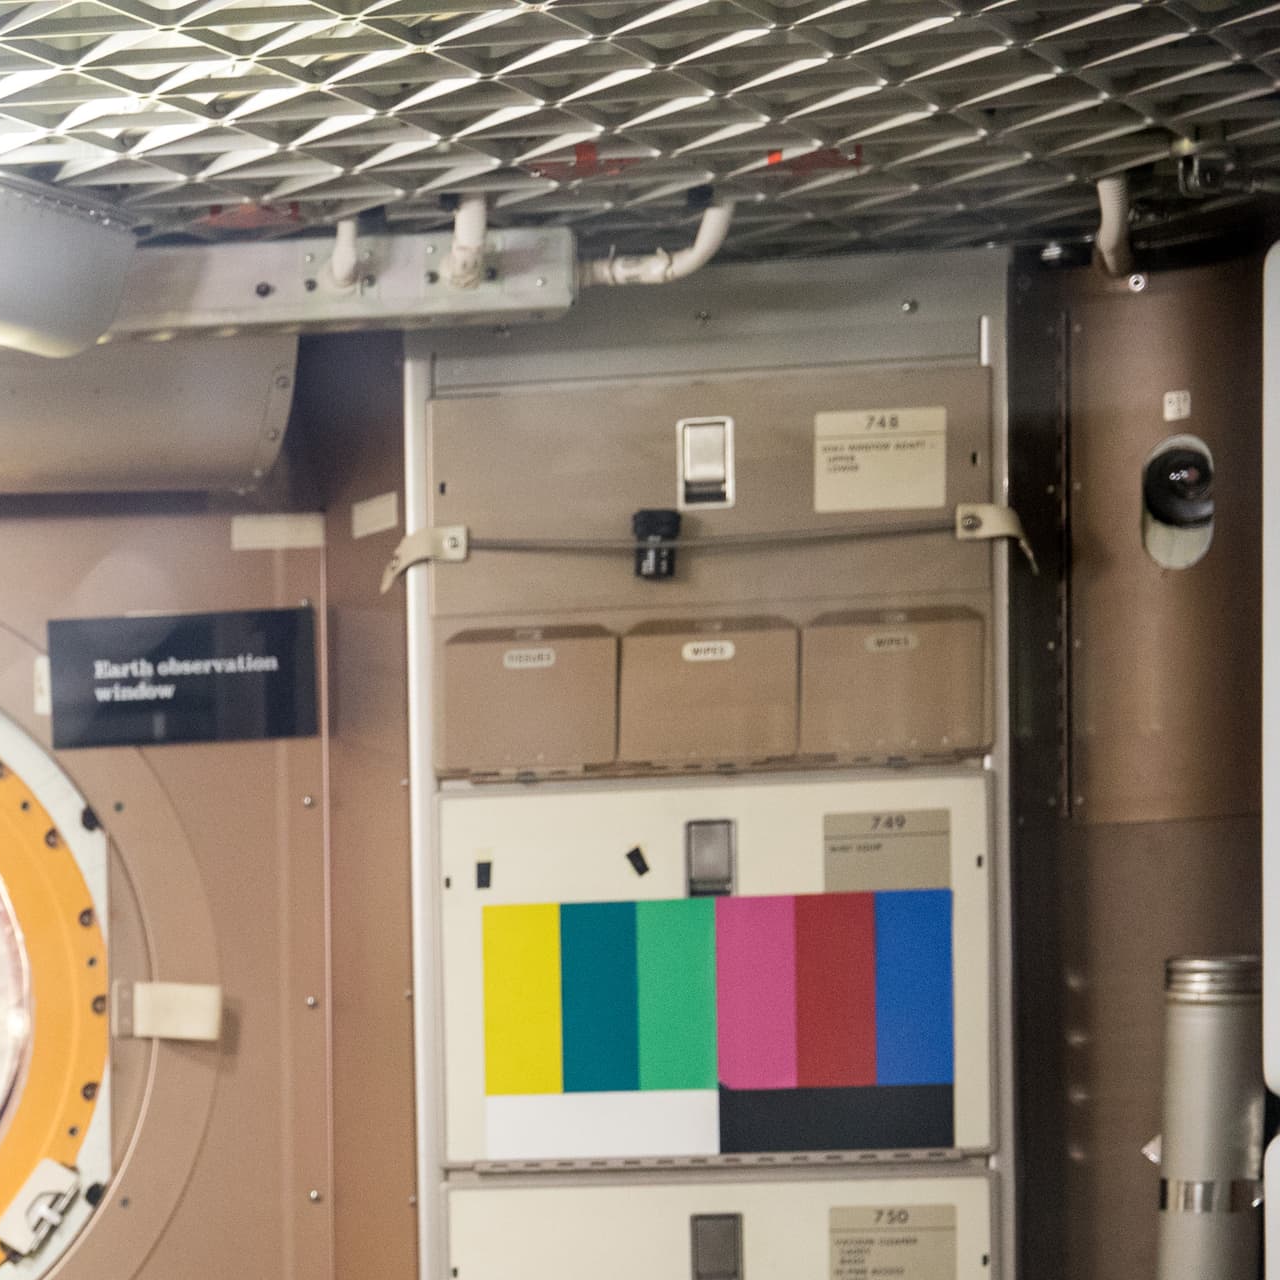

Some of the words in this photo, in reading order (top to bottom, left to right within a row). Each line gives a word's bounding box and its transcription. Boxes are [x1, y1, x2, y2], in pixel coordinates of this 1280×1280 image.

[93, 659, 155, 680] Earth
[156, 653, 279, 676] observation
[93, 682, 177, 702] window
[874, 1208, 909, 1225] 750
